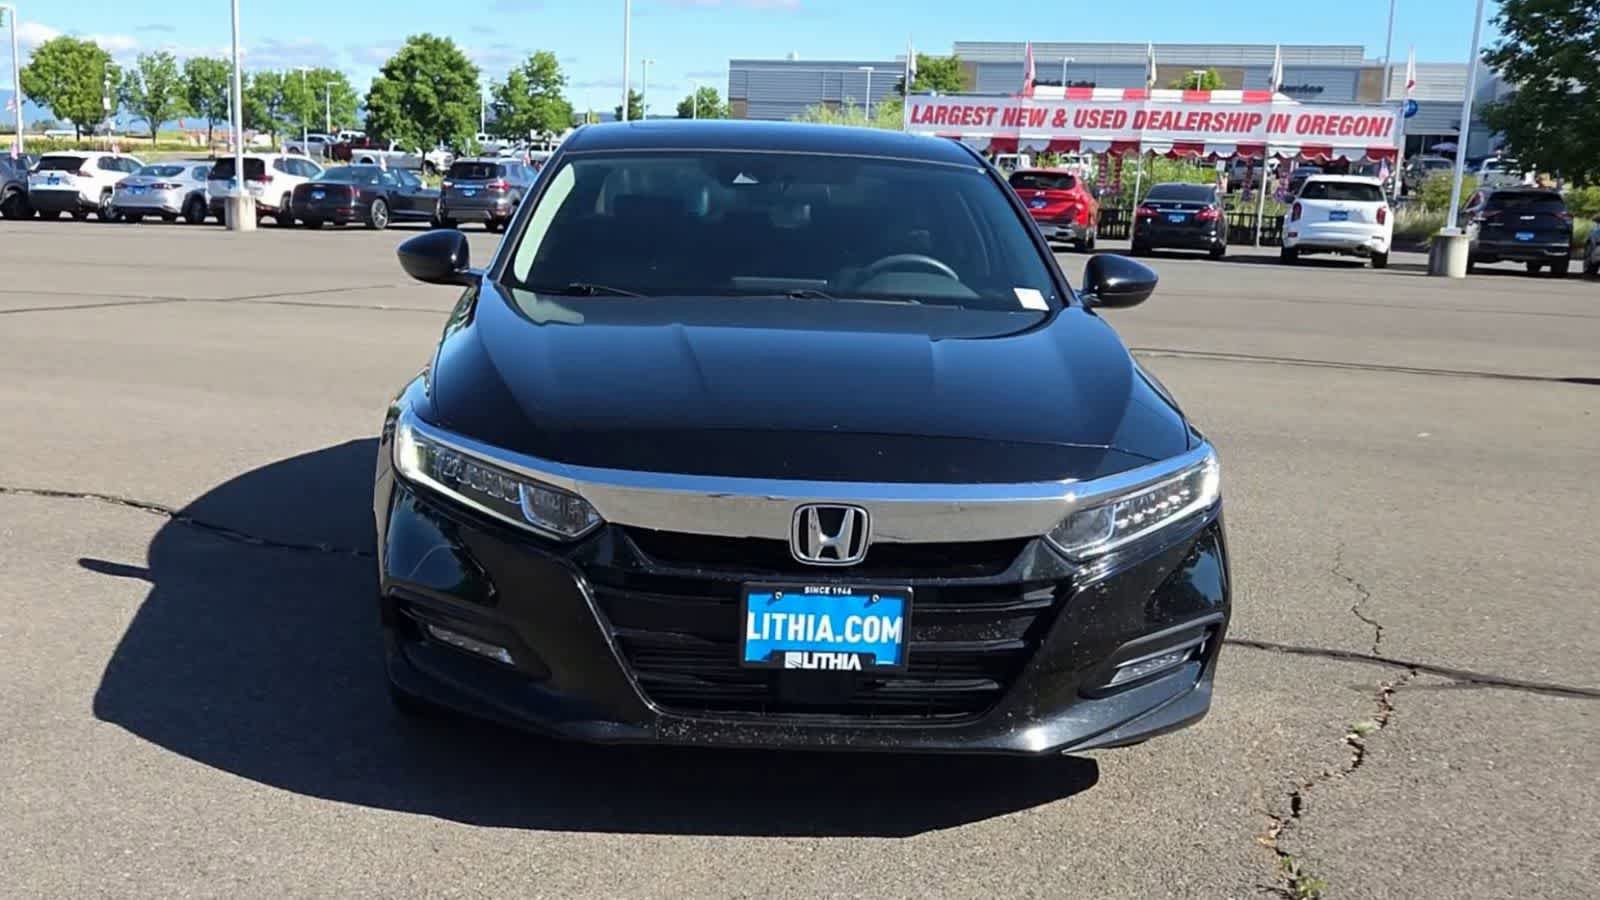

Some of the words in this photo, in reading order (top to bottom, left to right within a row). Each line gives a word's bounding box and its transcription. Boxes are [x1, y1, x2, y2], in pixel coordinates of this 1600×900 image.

[910, 103, 998, 127] LARGEST
[1001, 106, 1049, 127] NEW
[1051, 108, 1068, 128] &
[1072, 108, 1128, 130] USED
[1131, 104, 1263, 133] DEALERSHIP
[1266, 112, 1291, 133] IN
[1295, 113, 1393, 137] OREGON!
[804, 586, 830, 595] SINCE
[746, 611, 903, 645] LITHIA.COM
[802, 652, 862, 671] LITHIA
